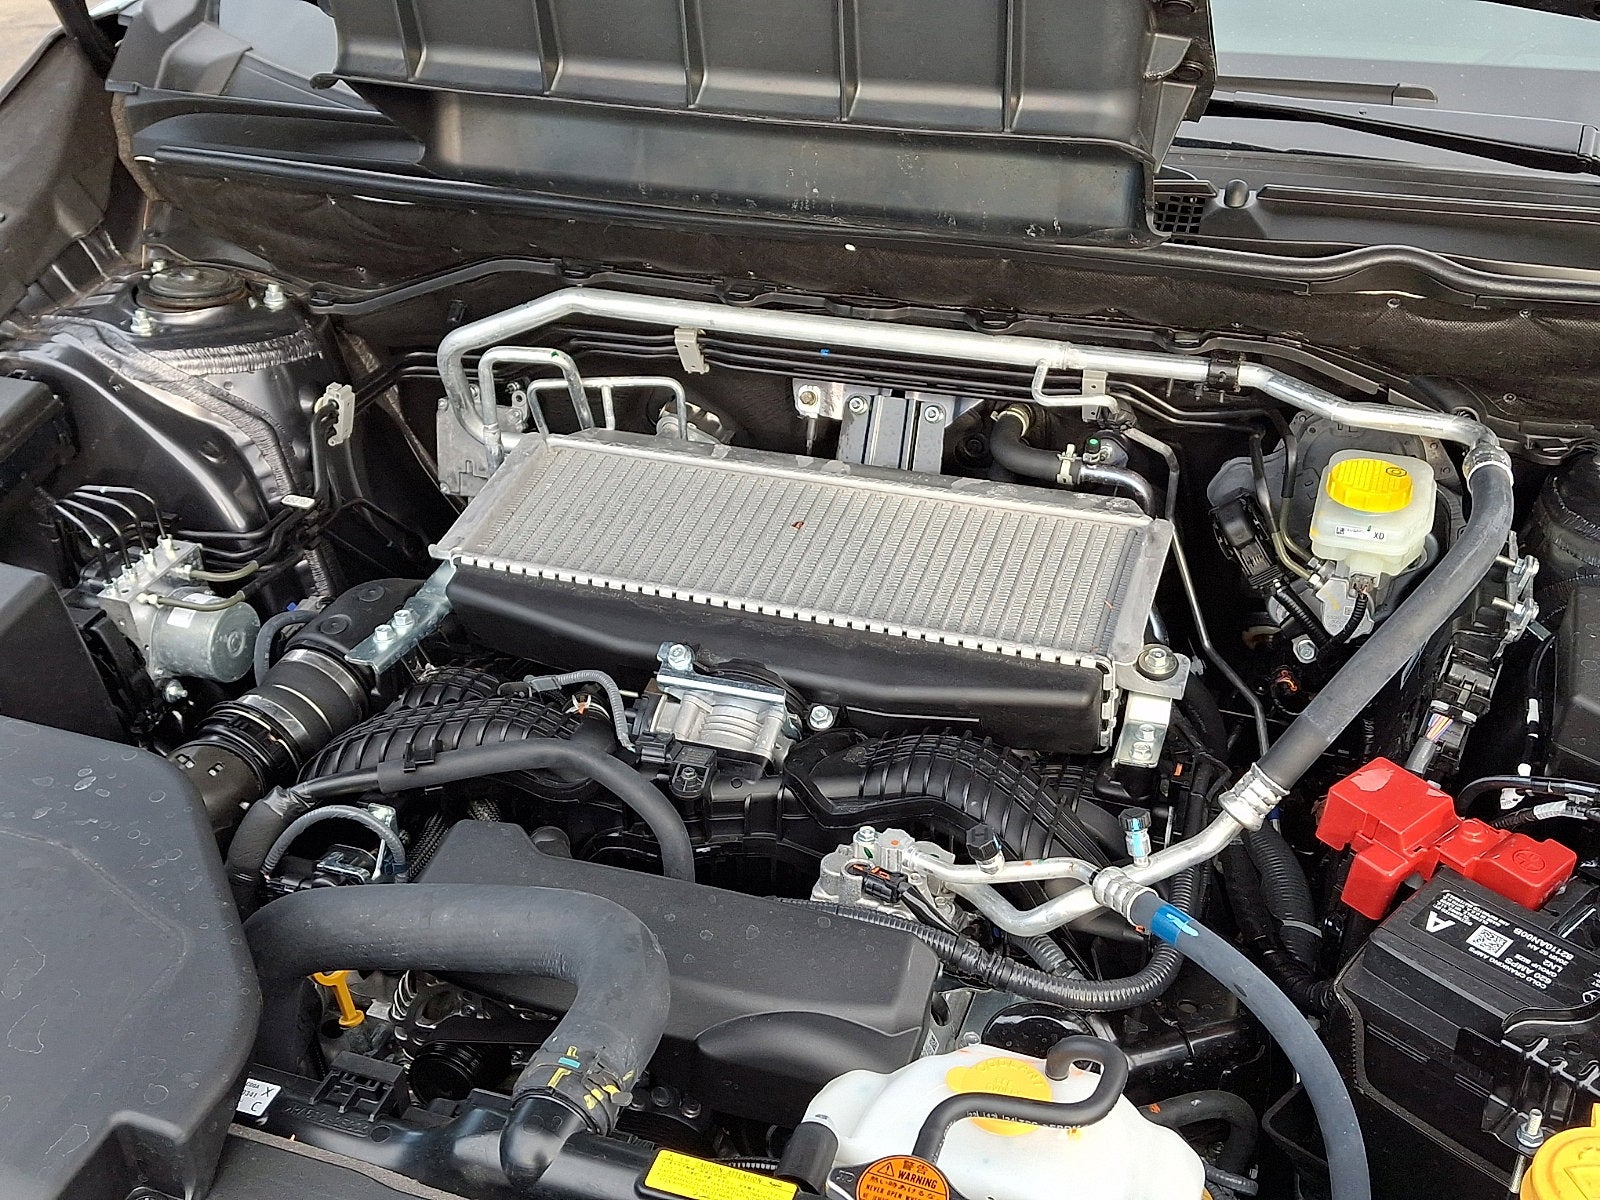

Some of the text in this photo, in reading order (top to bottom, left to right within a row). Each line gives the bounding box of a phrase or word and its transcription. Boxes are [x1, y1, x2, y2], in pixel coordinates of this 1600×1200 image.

[1425, 910, 1455, 933] A
[1526, 943, 1540, 952] AH
[1468, 947, 1547, 989] COLD CRANKING AMPS
[1504, 957, 1552, 984] 620 AMPS
[1514, 953, 1558, 978] GROUP SIZE
[1542, 959, 1564, 973] LN2
[261, 1087, 274, 1097] X
[251, 1102, 262, 1111] C
[897, 1170, 938, 1190] WARNING
[866, 1184, 885, 1194] NEVER
